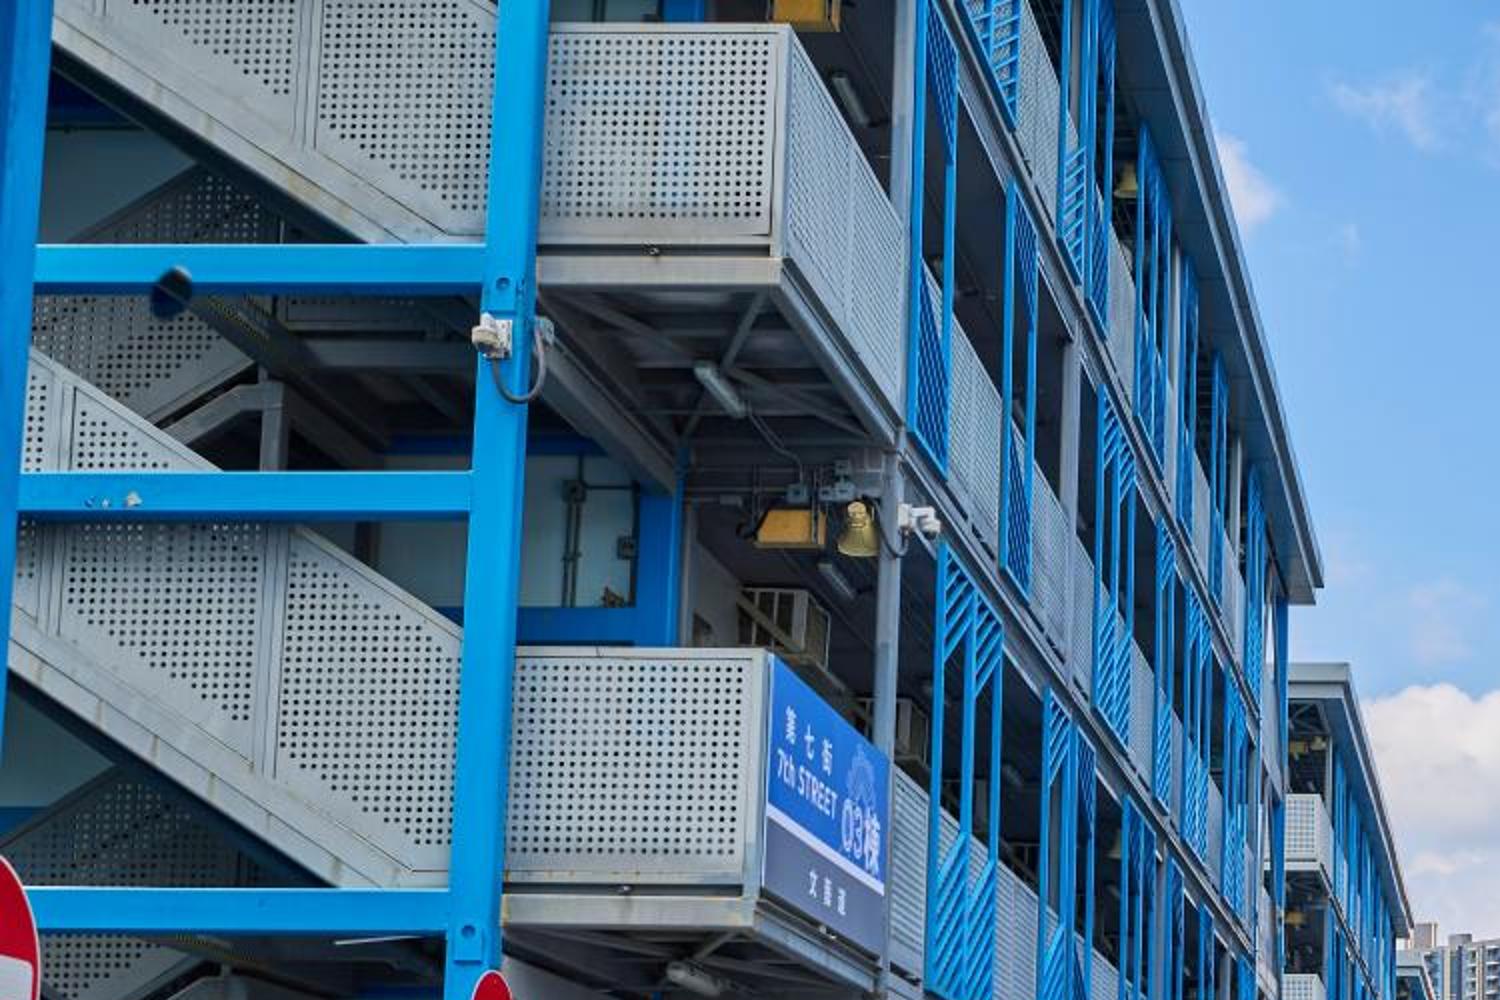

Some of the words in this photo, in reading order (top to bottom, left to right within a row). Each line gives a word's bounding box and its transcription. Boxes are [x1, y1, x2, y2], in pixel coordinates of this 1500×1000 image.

[785, 705, 833, 777] 第七街
[777, 748, 796, 789] 7th
[798, 766, 838, 820] STREET
